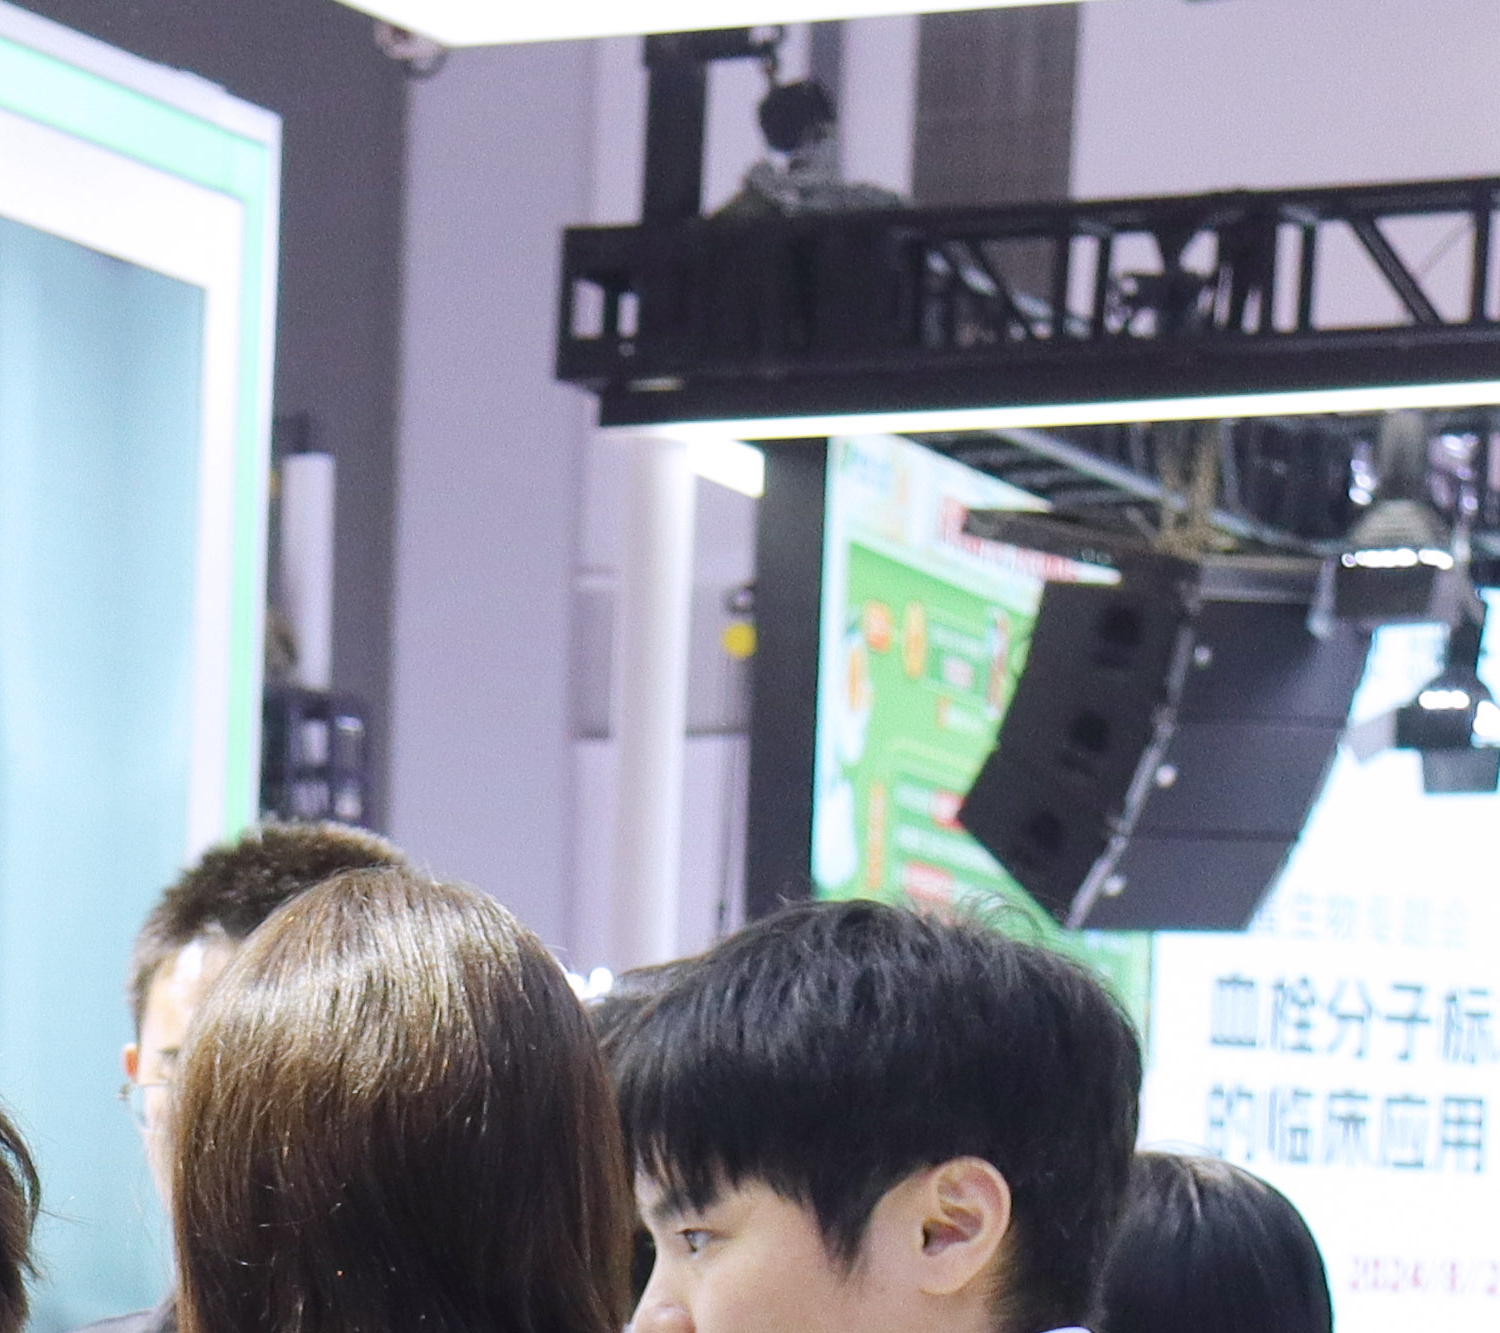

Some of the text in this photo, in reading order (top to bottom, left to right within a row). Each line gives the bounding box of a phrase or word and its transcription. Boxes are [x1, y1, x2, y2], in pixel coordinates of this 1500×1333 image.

[1206, 1082, 1487, 1176] 的临床应用
